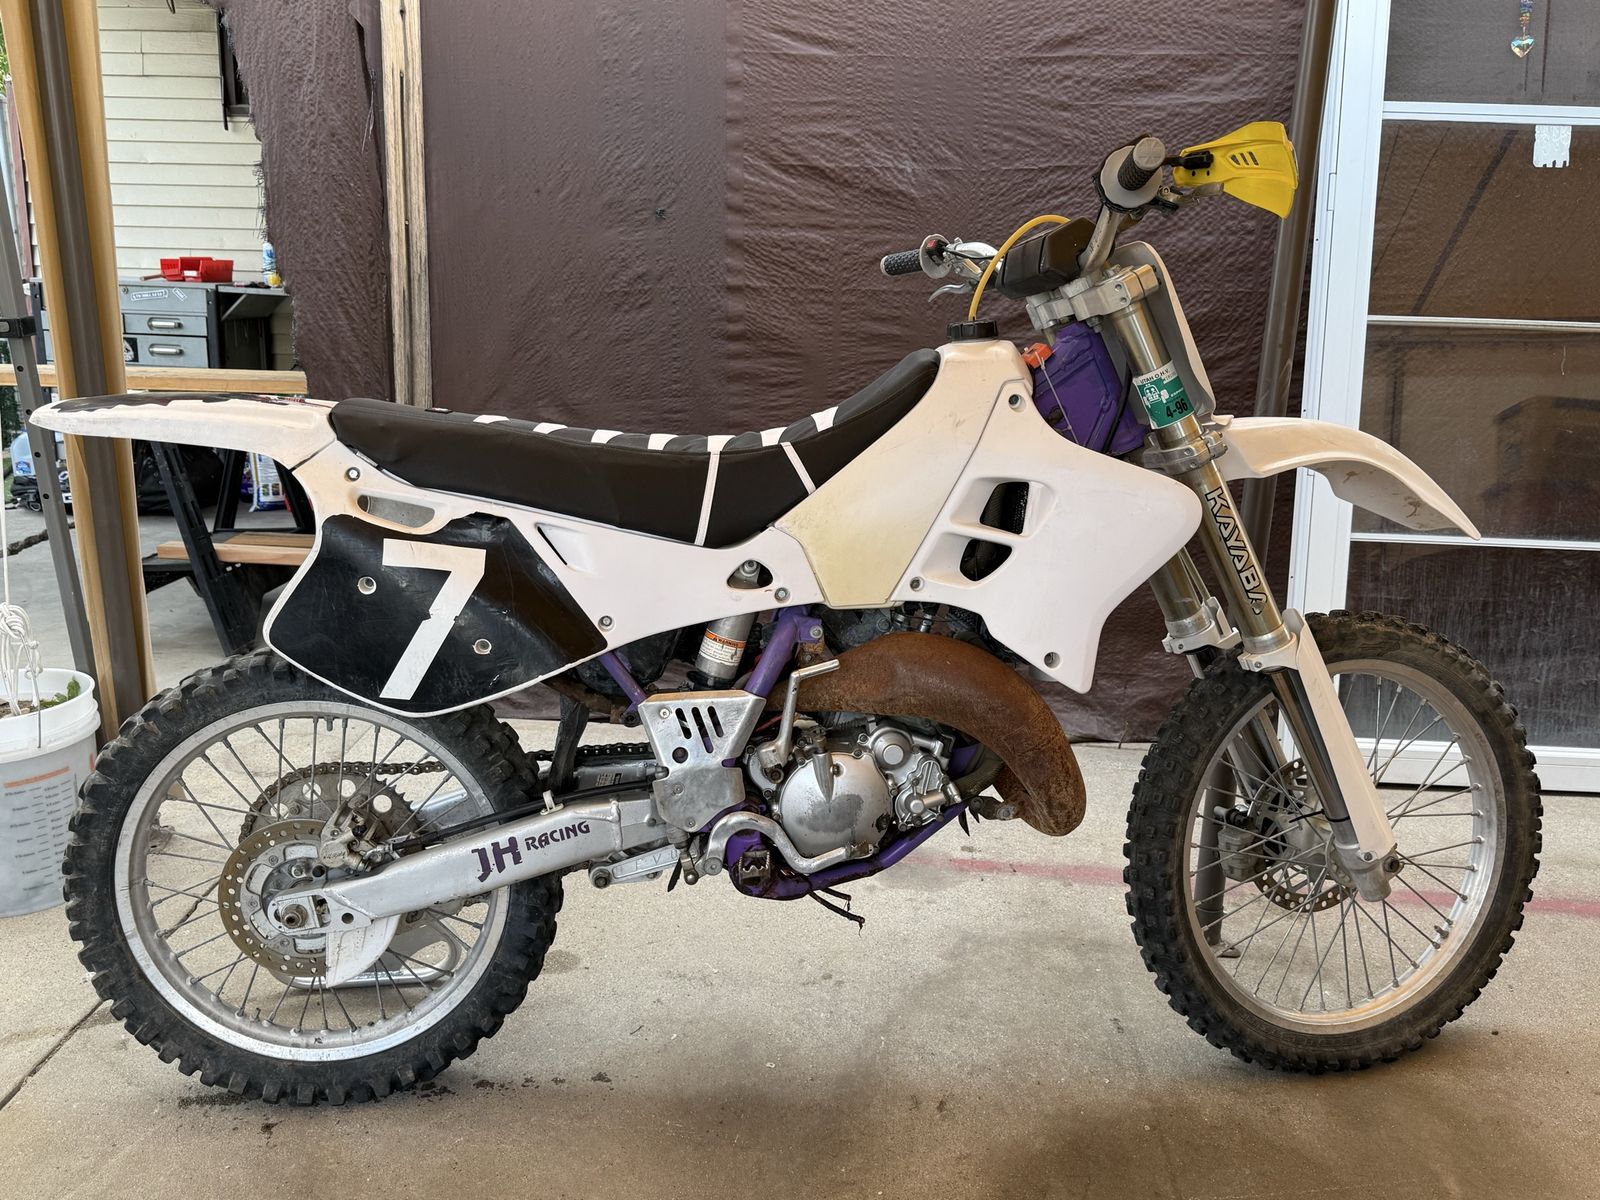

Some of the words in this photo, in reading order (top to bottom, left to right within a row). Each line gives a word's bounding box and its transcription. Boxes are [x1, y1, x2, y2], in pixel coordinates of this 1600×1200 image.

[1165, 399, 1189, 418] 4-96
[379, 538, 487, 700] 7
[471, 836, 523, 883] JH
[524, 820, 591, 851] RACING
